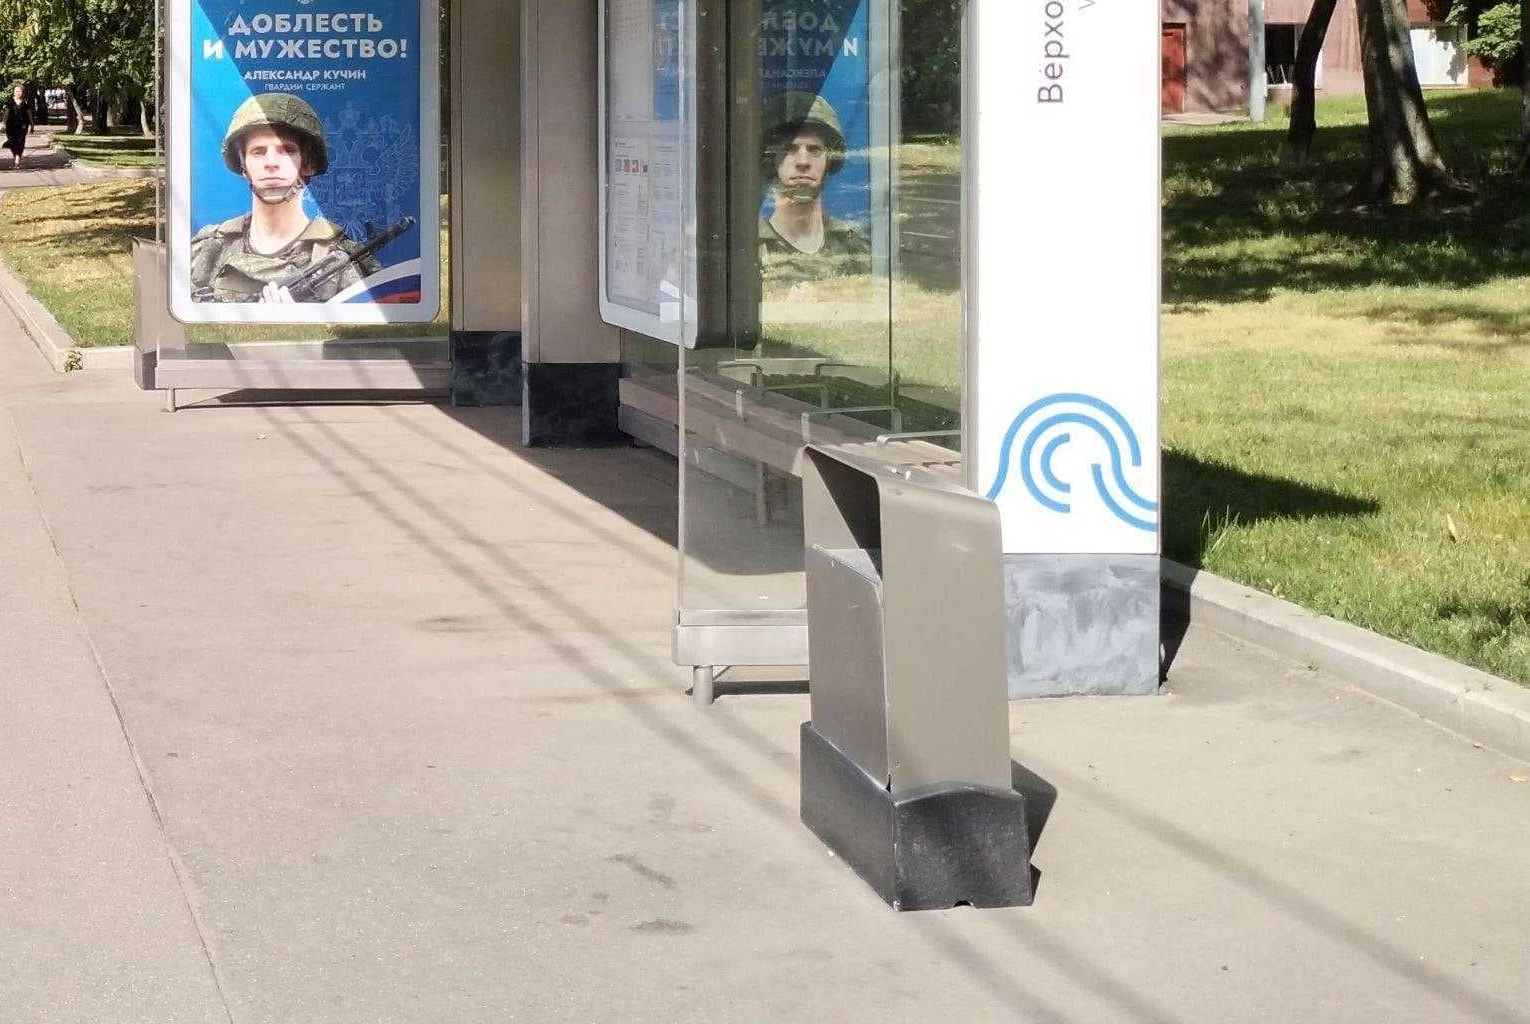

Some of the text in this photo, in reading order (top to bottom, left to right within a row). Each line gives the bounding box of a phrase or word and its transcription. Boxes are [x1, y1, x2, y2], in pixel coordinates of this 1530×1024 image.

[228, 13, 383, 36] ДОБЛЕСТЬ
[203, 38, 407, 60] И МУЖЕСТВО!
[244, 69, 366, 81] АЛЕКСАНДР КУЧИН
[305, 82, 346, 91] СЕРЖАНТ
